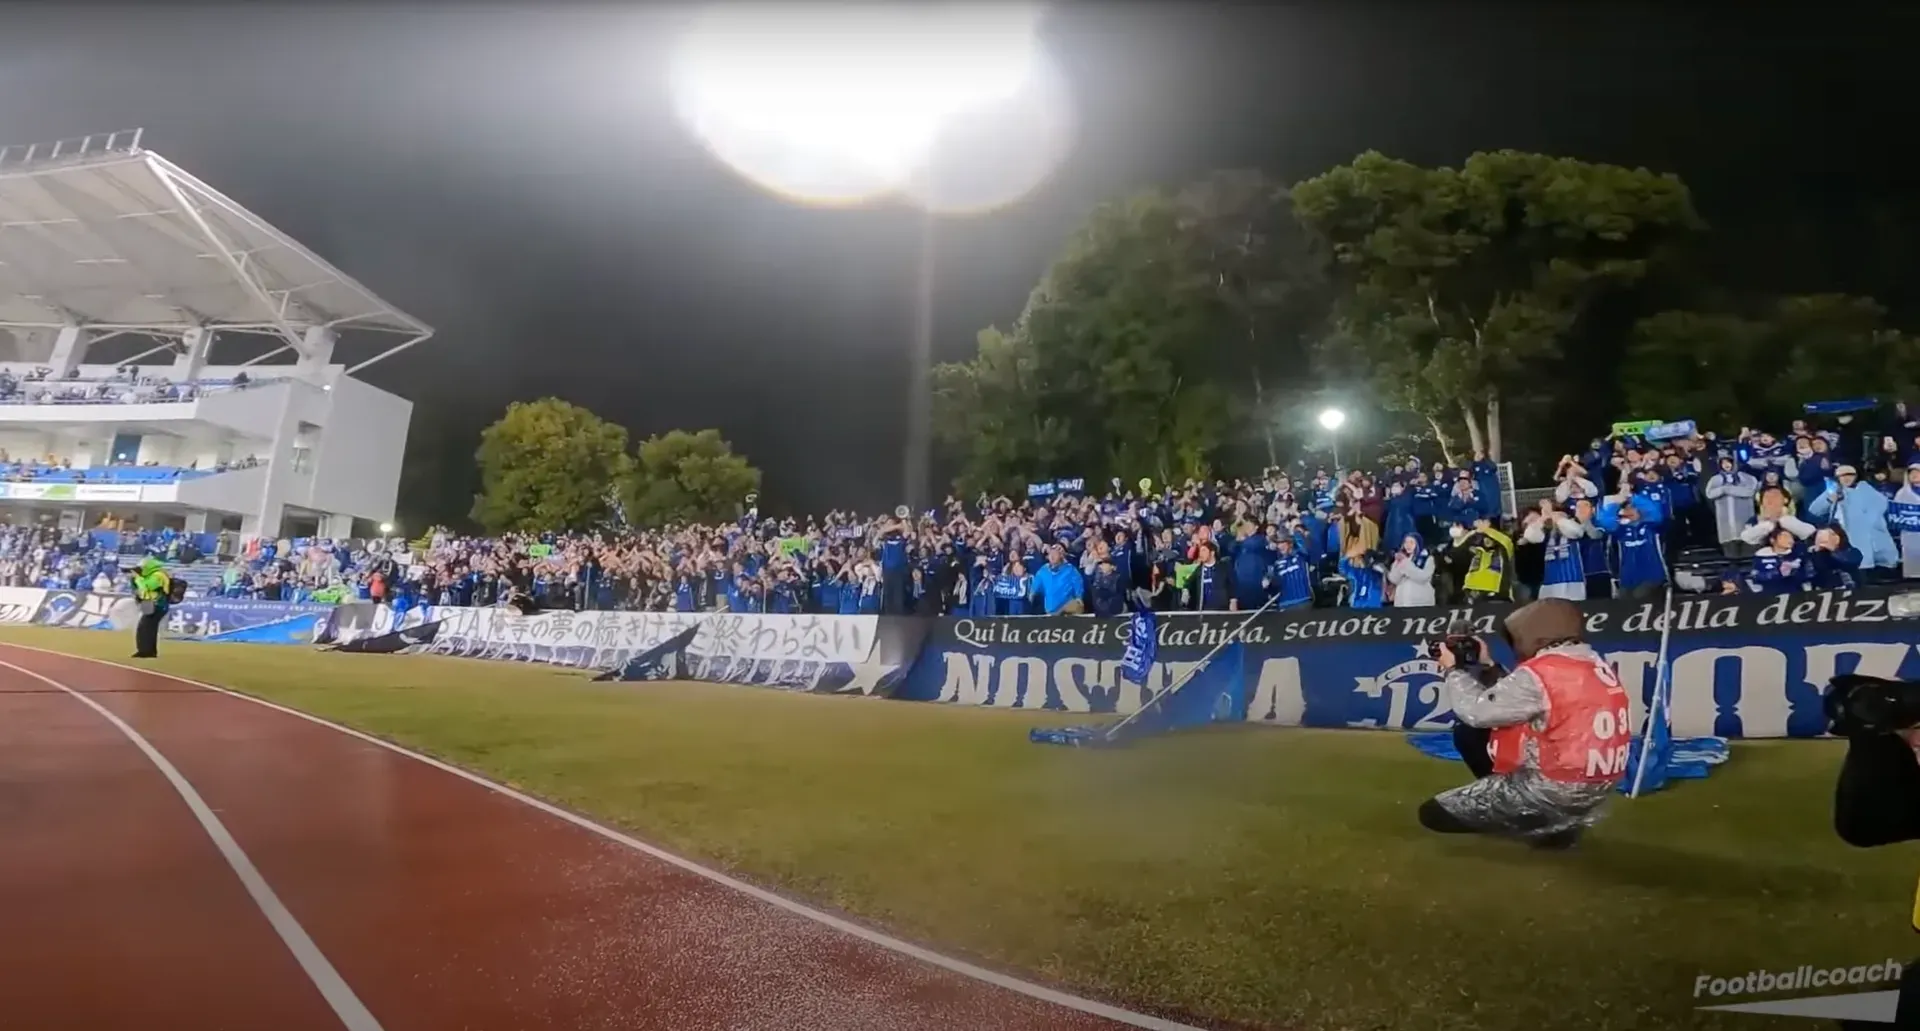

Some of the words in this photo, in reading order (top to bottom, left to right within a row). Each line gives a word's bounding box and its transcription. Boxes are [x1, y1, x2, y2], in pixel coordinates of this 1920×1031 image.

[954, 619, 996, 648] Qui
[1001, 621, 1023, 643] la
[1026, 627, 1075, 644] casa
[1082, 624, 1108, 645] di
[1284, 614, 1392, 642] scuote
[1622, 601, 1740, 632] della
[1386, 681, 1455, 729] 12
